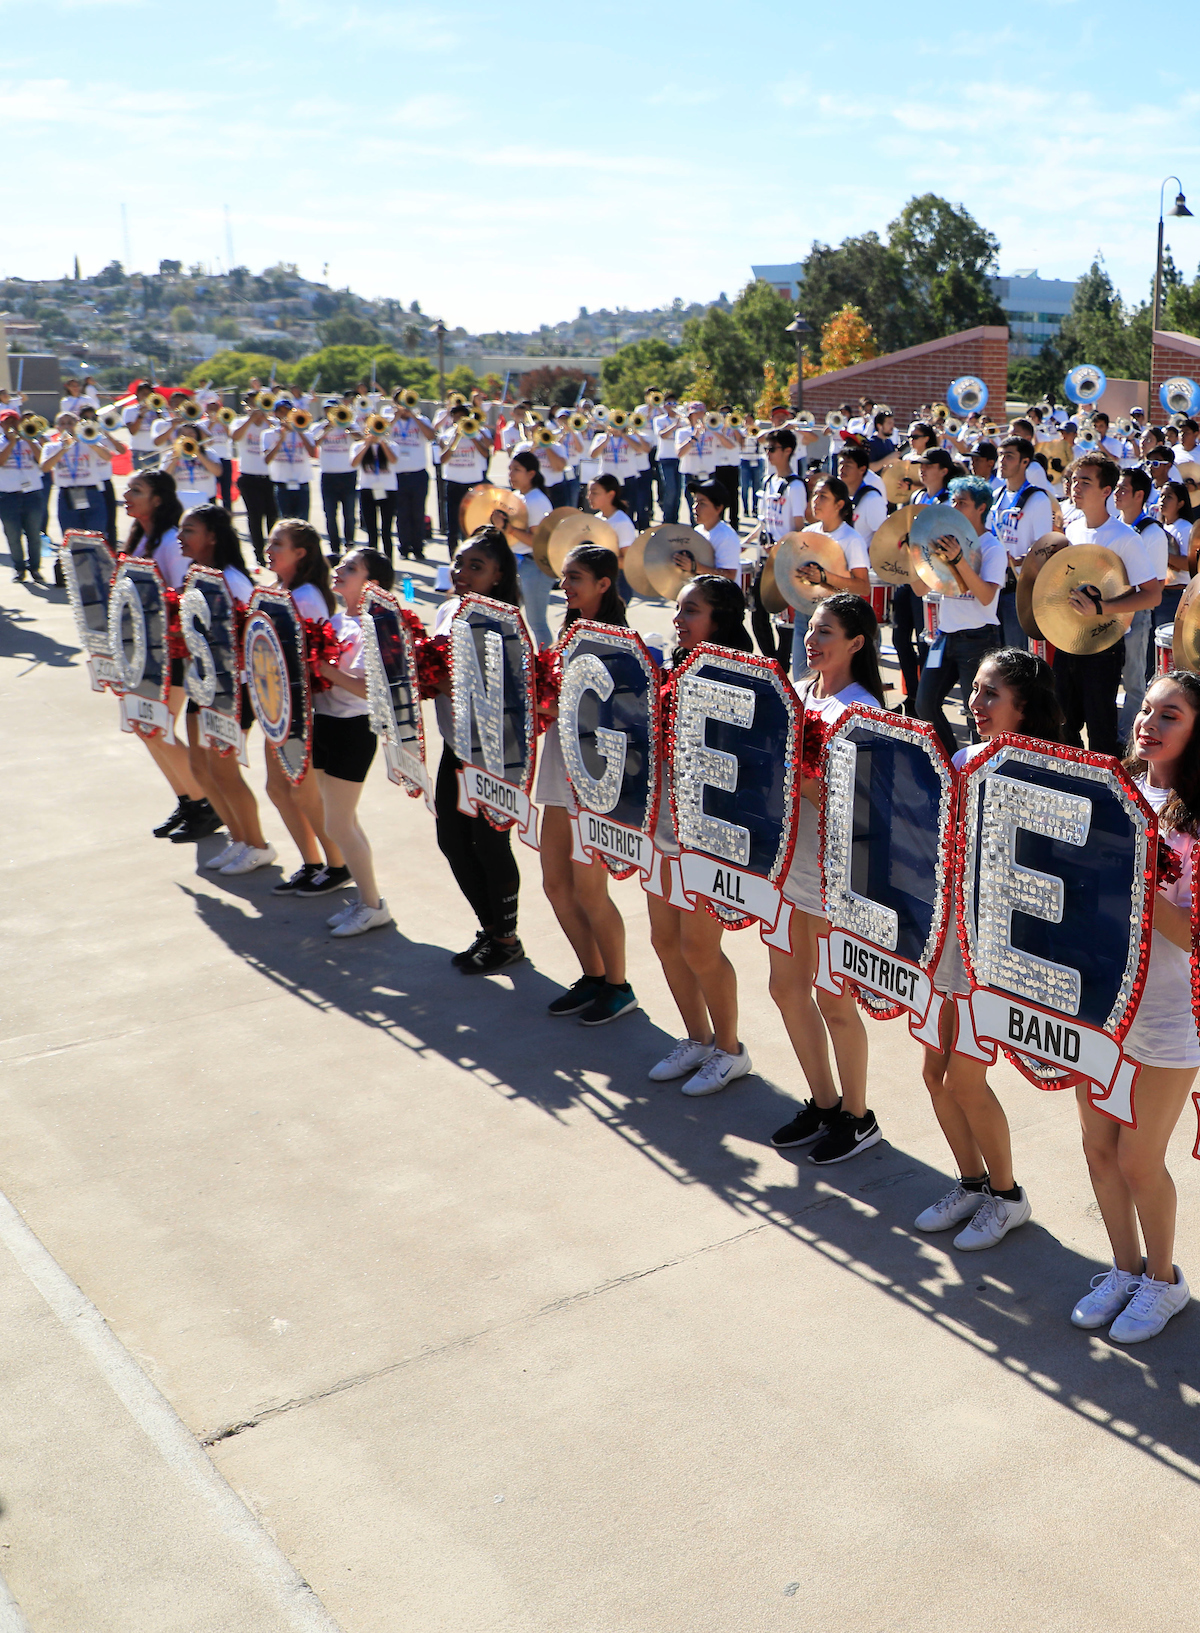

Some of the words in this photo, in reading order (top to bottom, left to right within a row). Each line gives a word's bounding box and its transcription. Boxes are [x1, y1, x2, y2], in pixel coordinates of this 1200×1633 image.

[880, 560, 909, 577] Zildjian
[1091, 619, 1117, 638] Zildjian
[138, 701, 153, 721] LOS
[204, 710, 238, 743] ANGELES
[475, 774, 520, 815] SCHOOL
[588, 817, 643, 861] DISTRICT
[713, 868, 745, 904] ALL
[843, 939, 920, 1002] DISTRICT
[1008, 1006, 1081, 1063] BAND
